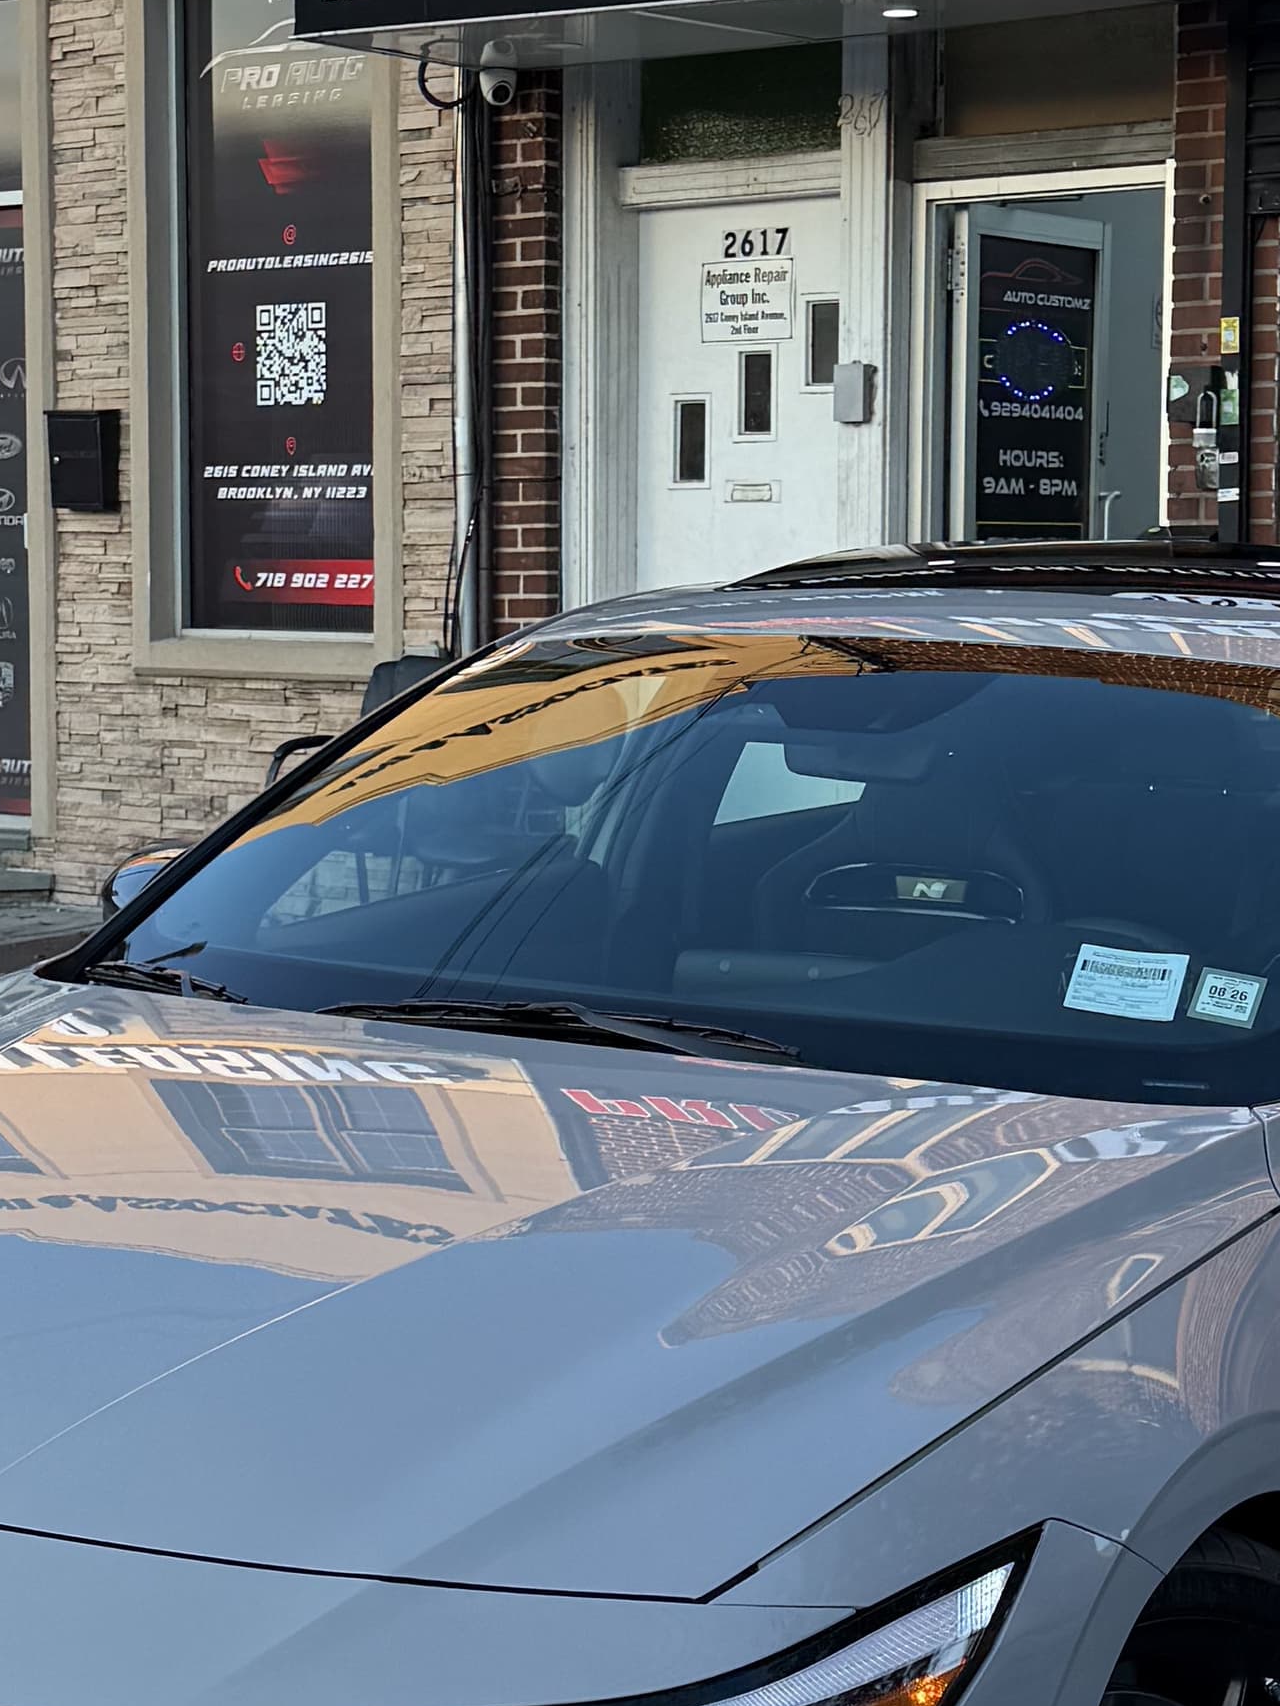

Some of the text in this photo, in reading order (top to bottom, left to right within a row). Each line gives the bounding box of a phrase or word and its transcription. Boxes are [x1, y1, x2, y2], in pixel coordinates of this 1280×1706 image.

[221, 54, 368, 93] PRO AUTO
[242, 87, 344, 110] LEASING
[723, 227, 790, 259] 2617
[207, 250, 373, 273] PROAUTOLEASING2615
[704, 266, 789, 289] Appliance Repair
[719, 288, 770, 307] Group Inc.
[1003, 289, 1092, 311] AUTO CUSTOMZ
[990, 402, 1084, 422] 9294041404
[998, 448, 1064, 469] HOURS:
[203, 463, 374, 479] 2615 CONEY ISLAND AV
[302, 486, 323, 500] NY
[325, 486, 368, 500] 11223
[982, 476, 1025, 496] 9AM
[1039, 478, 1078, 497] 8PM
[254, 572, 374, 590] 718 902 227
[1229, 988, 1249, 1002] 26
